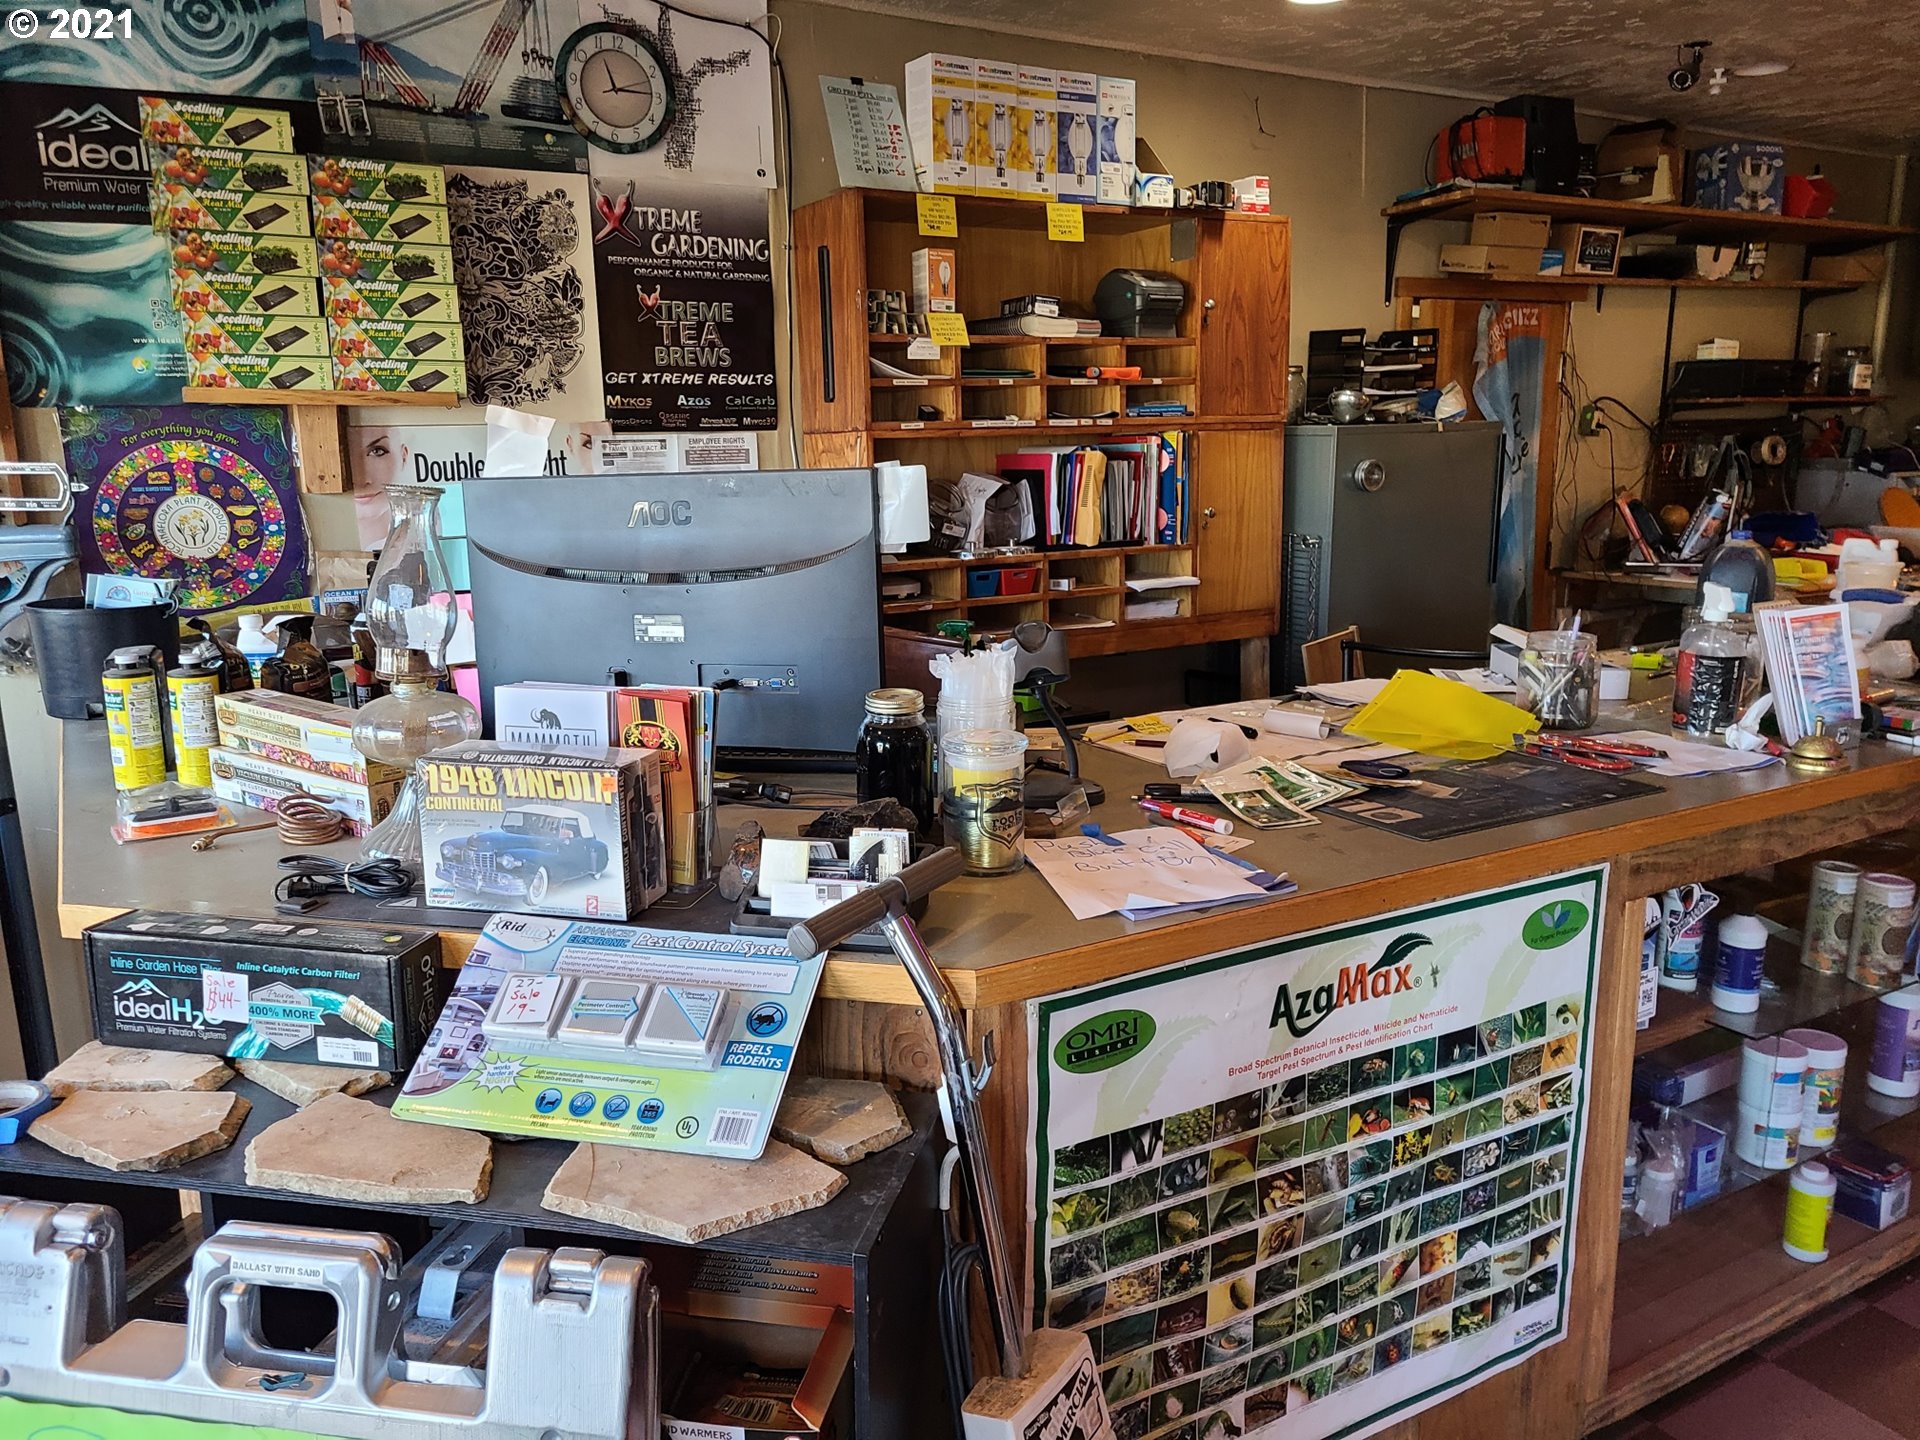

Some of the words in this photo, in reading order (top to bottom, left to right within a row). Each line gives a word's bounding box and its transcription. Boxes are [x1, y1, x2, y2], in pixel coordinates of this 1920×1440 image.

[595, 35, 604, 50] 11
[612, 35, 624, 50] 12
[573, 49, 588, 63] 10
[634, 44, 639, 58] 1
[649, 65, 657, 79] 2
[934, 60, 969, 71] Plantmax
[979, 65, 1012, 76] Plantmax
[569, 73, 578, 85] 9
[1019, 73, 1052, 83] Plantmax
[1060, 77, 1092, 87] Plantmax
[574, 97, 584, 111] 8
[655, 92, 663, 106] 3
[174, 101, 224, 118] Seedling
[648, 112, 656, 126] 4
[592, 120, 600, 134] 7
[632, 127, 641, 140] 5
[610, 129, 619, 143] 6
[37, 132, 150, 171] ideal
[192, 147, 243, 163] Seedling
[338, 158, 386, 173] Seedling
[43, 177, 100, 192] Premium
[103, 180, 142, 194] Water
[193, 188, 243, 203] Seedling
[51, 200, 86, 210] reliable
[88, 202, 115, 211] water
[343, 198, 389, 213] Seedling
[202, 231, 253, 245] Seedling
[347, 240, 394, 254] Seedling
[651, 233, 769, 262] GARDENING
[608, 255, 671, 268] PERFORMANCE
[672, 259, 716, 271] PRODUCTS
[717, 262, 734, 271] FOR
[204, 272, 252, 287] Seedling
[634, 268, 674, 279] ORGANIC
[675, 269, 682, 279] &
[683, 270, 721, 281] NATURAL
[722, 272, 771, 283] GARDENING
[353, 280, 399, 293] Seedling
[215, 313, 264, 326] Seedling
[360, 320, 405, 333] Seedling
[656, 320, 724, 347] TEA
[220, 355, 269, 367] Seedling
[655, 346, 732, 368] BREWS
[363, 359, 408, 370] Seedling
[605, 372, 637, 385] GET
[641, 372, 704, 386] XTREME
[708, 374, 774, 386] RESULTS
[726, 395, 776, 406] CalCarb
[120, 434, 138, 447] For
[141, 422, 192, 438] everything
[195, 426, 213, 438] you
[213, 433, 240, 447] grow.
[722, 437, 746, 445] RIGHTS
[414, 452, 486, 482] Double
[174, 497, 201, 506] PLANT
[204, 501, 228, 541] PRODUCTS
[157, 504, 184, 556] TECHNAFLORA
[207, 541, 221, 554] LTD
[248, 708, 267, 718] HEAVY
[268, 712, 284, 721] DUTY
[239, 727, 250, 735] FOR
[250, 730, 269, 740] CUSTOM
[270, 735, 288, 744] LENGTH
[479, 753, 546, 765] CONTINENTAL
[548, 757, 592, 767] LINCOLN
[245, 762, 265, 773] HEAVY
[266, 767, 284, 776] DUTY
[236, 781, 247, 789] FOR
[248, 783, 268, 794] CUSTOM
[426, 763, 497, 797] 1948
[502, 767, 612, 805] LINCOLN
[426, 797, 504, 812] CONTINENTAL
[572, 925, 637, 937] ADVANCED
[567, 934, 631, 948] ELECTRONIC
[633, 933, 675, 949] Pest
[675, 936, 740, 954] Control
[110, 957, 134, 969] Inline
[136, 958, 171, 972] Garden
[173, 961, 198, 974] Hose
[236, 962, 260, 972] Inline
[262, 963, 300, 976] Catalytic
[301, 967, 333, 978] Carbon
[334, 970, 361, 980] Filter!
[206, 974, 236, 989] Sale
[578, 1001, 604, 1010] Perimeter
[283, 1009, 316, 1020] MORE
[116, 1022, 145, 1033] Premium
[146, 1025, 166, 1035] Water
[168, 1027, 196, 1038] Filtration
[198, 1029, 228, 1041] Systems
[1066, 1017, 1139, 1050] OMRI
[1228, 1062, 1253, 1077] Broad
[1254, 1052, 1292, 1071] Spectrum
[1293, 1038, 1328, 1056] Botanical
[1329, 1027, 1372, 1045] Insecticide,
[1373, 1018, 1402, 1033] Miticide
[1403, 1014, 1417, 1026] and
[1418, 1004, 1459, 1021] Nematicide
[731, 1043, 773, 1056] REPELS
[1071, 1037, 1135, 1063] Listed
[1257, 1067, 1282, 1082] Target
[1282, 1060, 1300, 1073] Pest
[1300, 1049, 1336, 1068] Spectrum
[1337, 1047, 1345, 1055] &
[1345, 1040, 1363, 1053] Pest
[1363, 1029, 1412, 1047] Identification
[1412, 1022, 1434, 1035] Chart
[493, 1063, 511, 1072] works
[725, 1054, 783, 1069] RODENTS
[487, 1069, 507, 1078] harder
[232, 1261, 272, 1273] BALLAST
[274, 1265, 296, 1275] WITH
[297, 1268, 322, 1278] SAND
[680, 1426, 733, 1440] WARMERS
